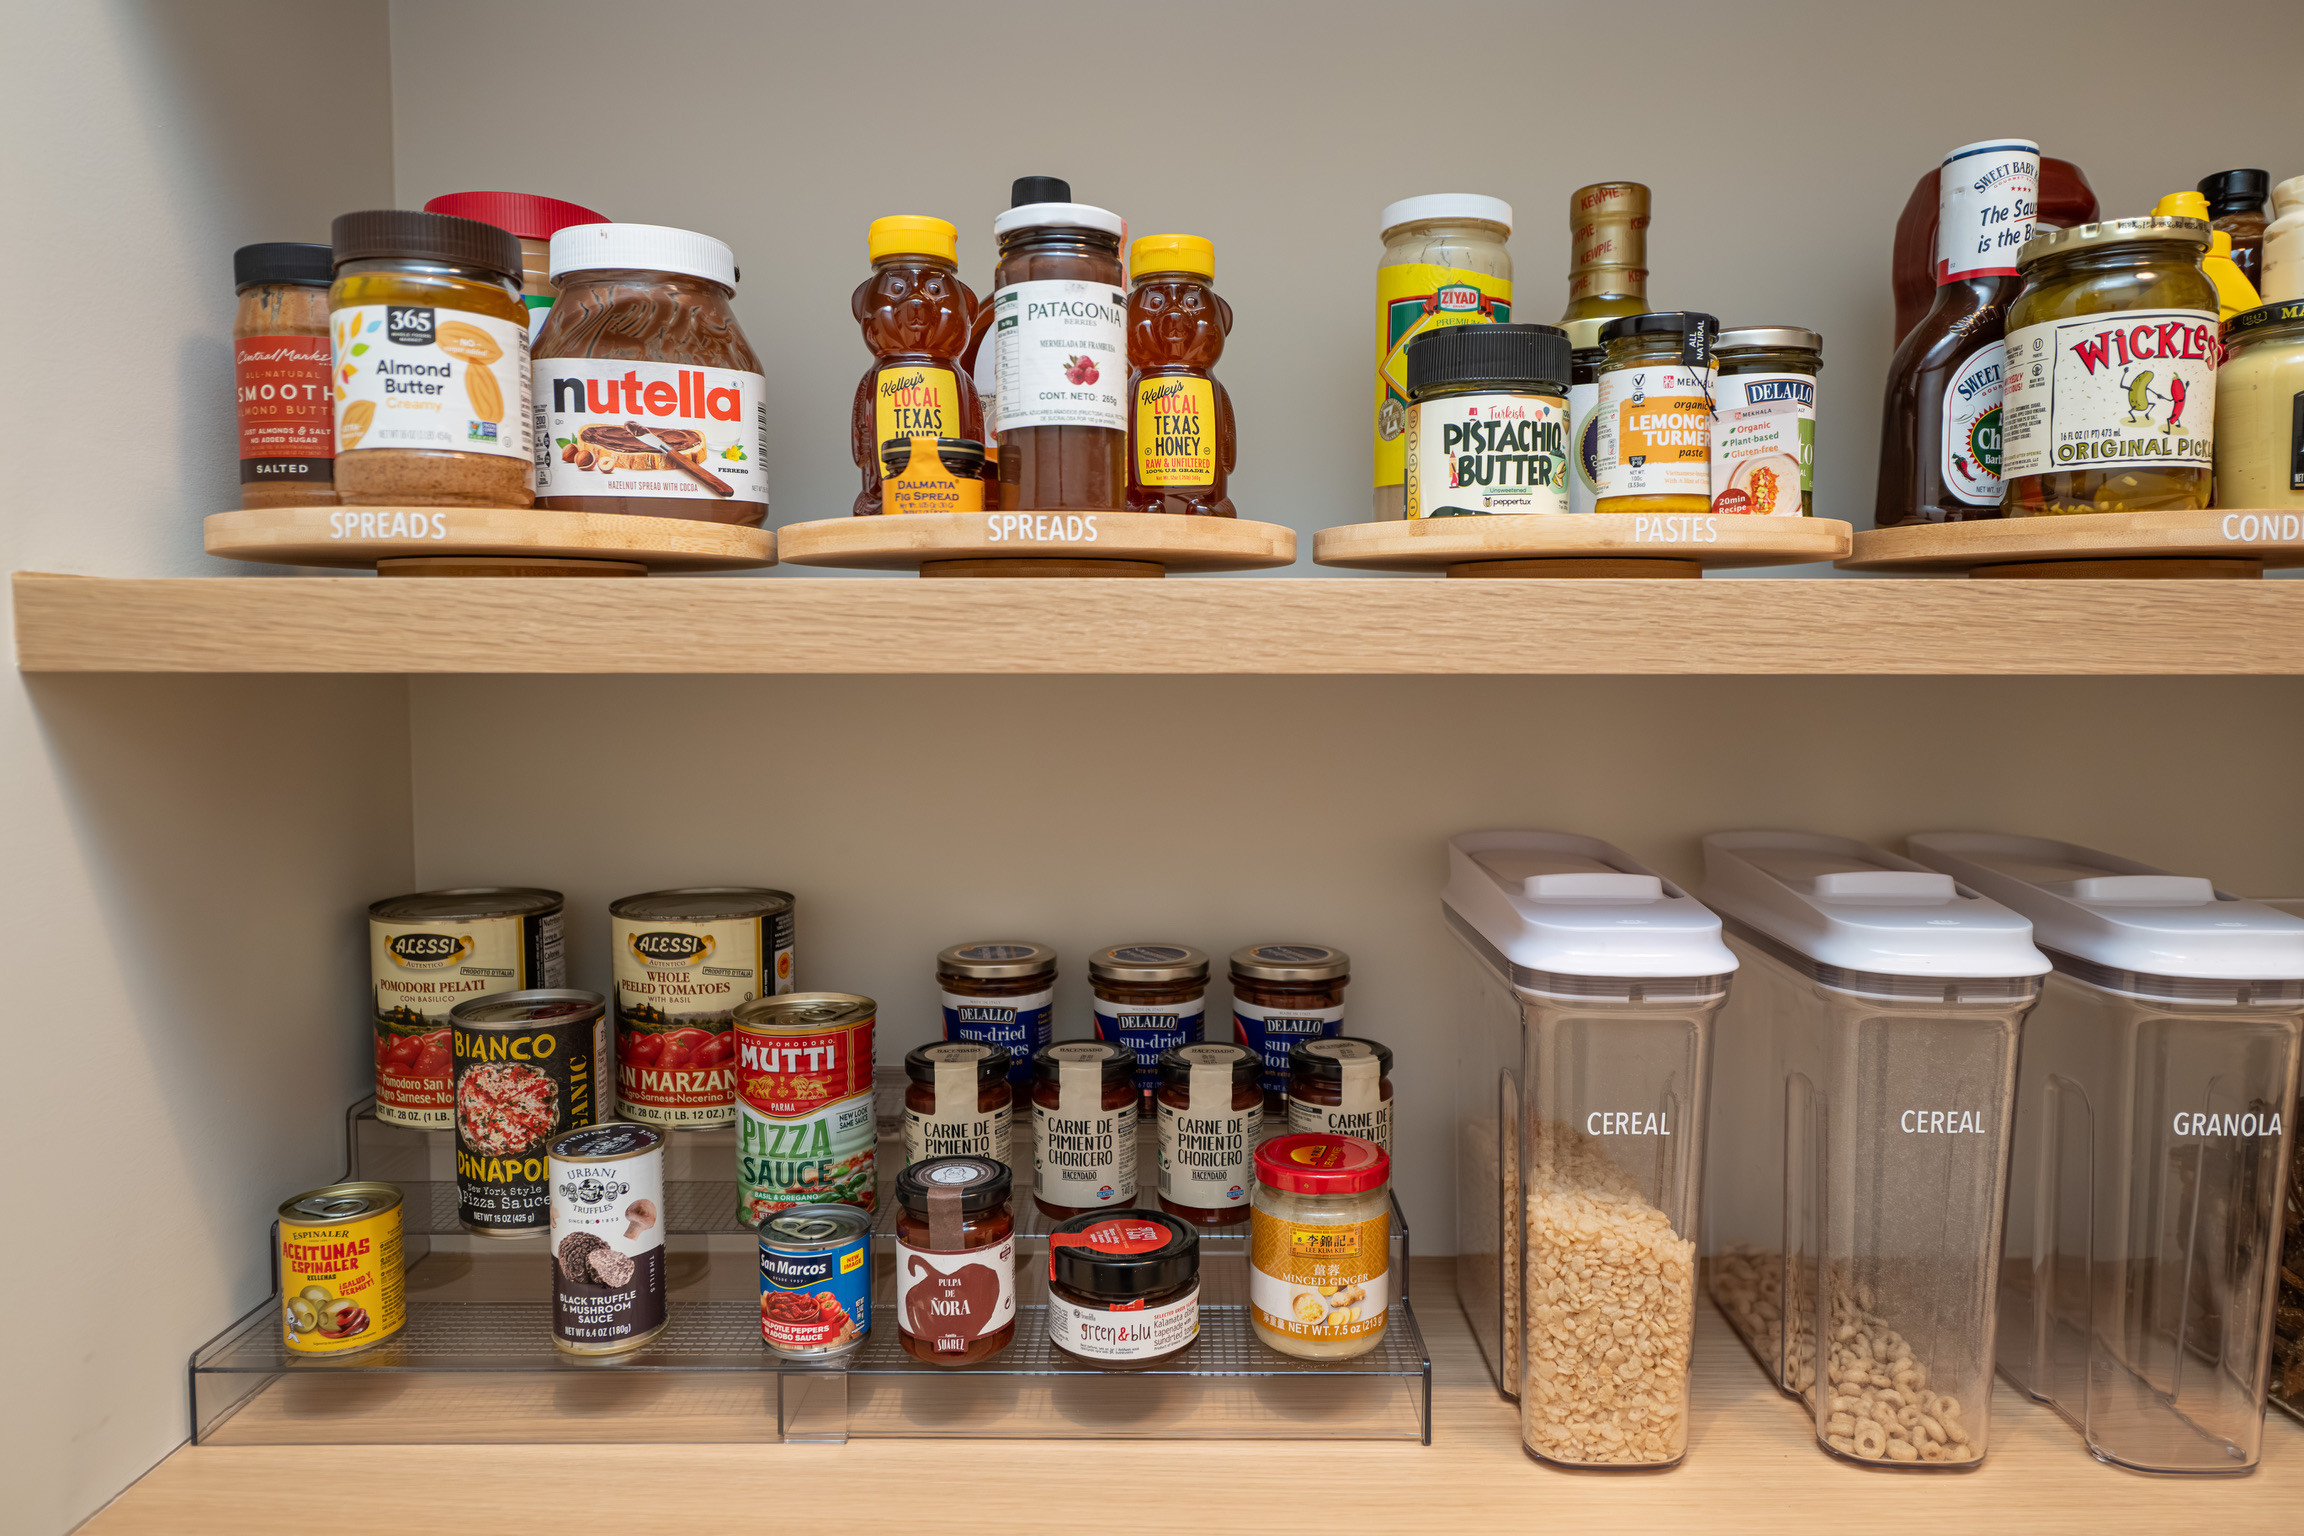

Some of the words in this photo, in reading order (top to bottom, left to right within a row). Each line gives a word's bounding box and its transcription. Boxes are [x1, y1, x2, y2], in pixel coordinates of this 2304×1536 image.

[1974, 164, 2009, 194] SWEET
[2013, 161, 2035, 176] BABY
[1581, 187, 1620, 211] KEWPIE
[1581, 240, 1613, 265] KEWPIE
[1441, 291, 1477, 304] ZIYAD
[390, 309, 431, 331] 365
[1028, 301, 1122, 328] PATAGONIA
[1064, 318, 1097, 326] BERRIES
[1689, 332, 1697, 347] ALL
[275, 348, 333, 361] Marke
[245, 370, 321, 379] ALL-NATURAL
[376, 360, 451, 378] Almond
[385, 378, 444, 395] Butter
[881, 372, 924, 397] Kelley's
[1957, 364, 2001, 401] SWEET
[553, 370, 741, 422] nutella
[894, 387, 941, 408] LOCAL
[1039, 391, 1068, 400] CONT.
[1070, 392, 1098, 401] NETO:
[1102, 394, 1117, 406] 265g
[1142, 380, 1184, 405] Kelley's
[1751, 383, 1812, 404] DELALLO
[386, 396, 442, 413] Creamy
[1155, 395, 1199, 414] LOCAL
[894, 409, 942, 429] TEXAS
[1489, 406, 1526, 420] Turkish
[1742, 408, 1772, 418] MEKHALA
[1154, 415, 1199, 435] TEXAS
[1737, 422, 1770, 434] Organic
[1443, 420, 1561, 454] PISTACHIO
[1730, 432, 1779, 446] Plant-based
[1156, 437, 1200, 456] HONEY
[1679, 449, 1703, 458] paste
[1731, 445, 1778, 458] Gluten-free
[2057, 438, 2172, 461] ORIGINAL
[256, 464, 309, 474] SALTED
[1146, 458, 1161, 469] RAW
[1164, 458, 1169, 468] &
[1172, 457, 1210, 468] UNFILTERED
[1457, 454, 1551, 487] BUTTER
[608, 481, 638, 490] HAZELNUT
[638, 481, 661, 491] SPREAD
[663, 482, 678, 491] WITH
[679, 483, 698, 492] COCOA
[898, 481, 956, 489] DALMATIA
[895, 492, 911, 501] FIG
[914, 492, 959, 501] SPREAD
[1493, 498, 1531, 507] peppertux
[1719, 495, 1746, 505] 20min
[1719, 505, 1746, 514] Recipe
[330, 512, 446, 539] SPREADS
[988, 514, 1097, 541] SPREADS
[1635, 516, 1717, 543] PASTES
[395, 938, 456, 954] ALESSI
[639, 936, 698, 953] ALESSI
[406, 961, 444, 969] AUTENTICO
[647, 972, 690, 983] WHOLE
[380, 978, 436, 994] POMODORI
[439, 979, 485, 993] PELATI
[621, 978, 656, 994] PEELED
[658, 982, 731, 995] TOMATOES
[418, 995, 455, 1003] BASILICO
[960, 1008, 1014, 1022] DELALLO
[1120, 1015, 1176, 1030] DELALLO
[959, 1025, 1026, 1041] sun-dried
[1267, 1019, 1321, 1033] DELALLO
[455, 1030, 557, 1062] BIANCO
[741, 1037, 761, 1046] SOLO
[1119, 1031, 1186, 1048] sun-dried
[741, 1044, 835, 1073] MUTTI
[382, 1074, 421, 1091] Pomodoro
[423, 1078, 444, 1091] San
[771, 1102, 796, 1112] PARMA
[839, 1112, 853, 1122] NEW
[854, 1107, 869, 1118] LOOK
[839, 1120, 854, 1130] SAME
[855, 1115, 869, 1125] SAUCE
[1047, 1117, 1091, 1135] CARNE
[1096, 1118, 1113, 1134] DE
[1177, 1117, 1222, 1135] CARNE
[1226, 1118, 1243, 1134] DE
[1328, 1112, 1372, 1129] CARNE
[1376, 1108, 1387, 1124] DE
[1587, 1112, 1670, 1135] CEREAL
[1901, 1110, 1985, 1133] CEREAL
[2173, 1112, 2282, 1137] GRANOLA
[742, 1111, 834, 1159] PIZZA
[924, 1121, 969, 1139] CARNE
[974, 1119, 990, 1135] DE
[925, 1136, 990, 1155] PIMIENTO
[1049, 1133, 1112, 1150] PIMIENTO
[1178, 1133, 1242, 1150] PIMIENTO
[1049, 1149, 1113, 1167] CHORICERO
[1178, 1149, 1242, 1167] CHORICERO
[567, 1167, 616, 1180] URBANI
[744, 1156, 835, 1188] SAUCE
[1062, 1171, 1097, 1180] HACENDADO
[1192, 1171, 1227, 1180] HACENDADO
[467, 1184, 482, 1194] New
[484, 1186, 507, 1196] York
[510, 1185, 542, 1196] Style
[754, 1191, 773, 1200] BASIL
[774, 1192, 779, 1200] &
[780, 1193, 819, 1201] OREGANO
[463, 1190, 496, 1210] Pizza
[501, 1193, 550, 1210] Sauce
[573, 1203, 613, 1214] TRUFFLES
[292, 1230, 349, 1240] ESPINALER
[1306, 1234, 1346, 1247] 李錦記
[283, 1238, 370, 1261] ACEITUNAS
[291, 1258, 359, 1274] ESPINALER
[760, 1253, 776, 1272] San
[777, 1260, 827, 1276] Marcos
[843, 1258, 862, 1271] IMAGE
[846, 1253, 860, 1263] NEW
[340, 1278, 375, 1296] VERMUT!
[938, 1278, 962, 1287] PULPA
[1282, 1273, 1326, 1285] MINCED
[1330, 1273, 1368, 1286] GINGER
[560, 1293, 588, 1306] BLACK
[590, 1290, 637, 1305] TRUFFLE
[944, 1289, 956, 1298] DE
[570, 1301, 631, 1314] MUSHROOM
[930, 1298, 970, 1316] ÑORA
[578, 1314, 613, 1324] SAUCE
[1154, 1313, 1183, 1329] Kalamata
[1184, 1306, 1195, 1318] olive
[565, 1326, 575, 1335] NET
[576, 1328, 585, 1337] WT
[586, 1328, 596, 1337] 6.4
[598, 1327, 607, 1337] OZ
[609, 1323, 631, 1336] (180g)
[770, 1329, 793, 1340] ADOBO
[794, 1333, 823, 1341] SAUCE
